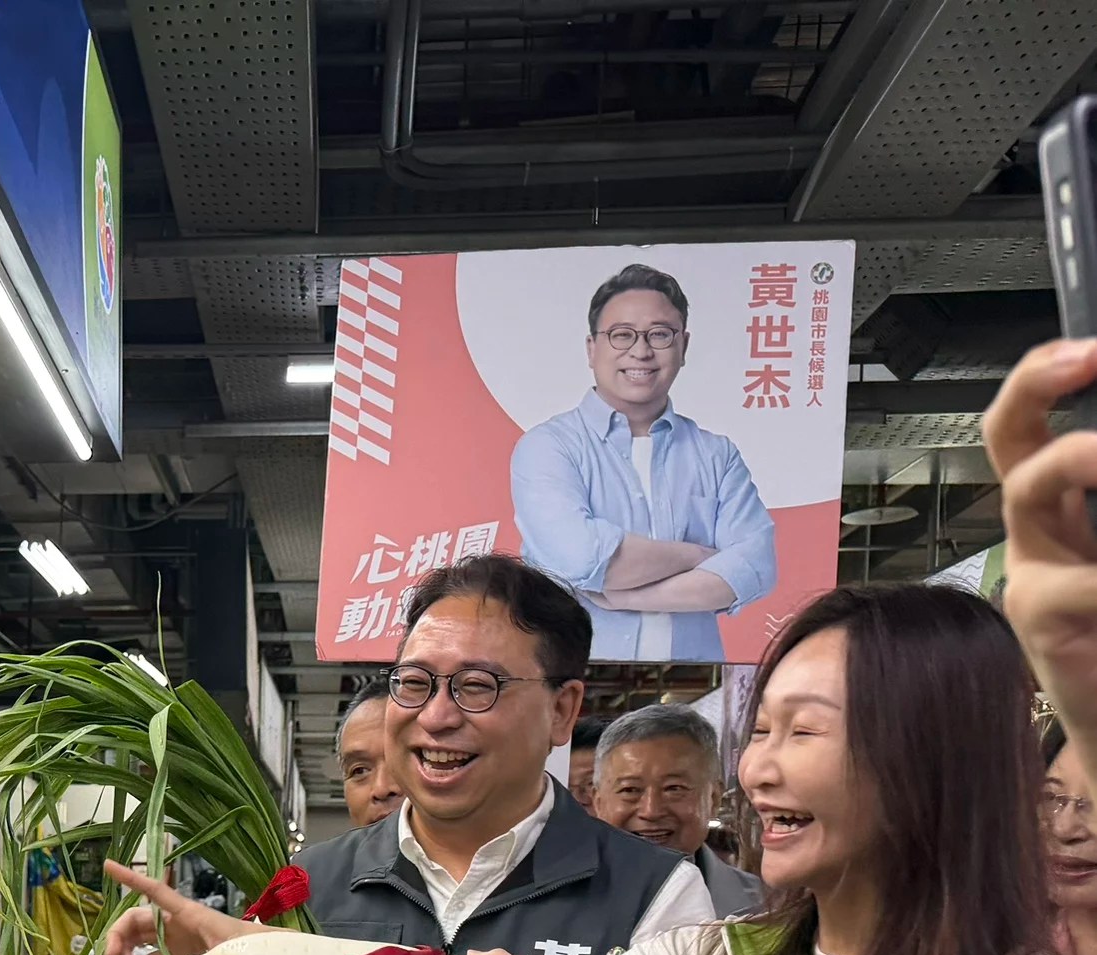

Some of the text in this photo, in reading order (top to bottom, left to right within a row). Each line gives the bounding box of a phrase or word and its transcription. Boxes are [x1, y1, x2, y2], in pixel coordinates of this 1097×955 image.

[742, 263, 798, 409] 黃世杰
[806, 289, 829, 408] 桃園市長候選人
[350, 521, 499, 584] 心桃園
